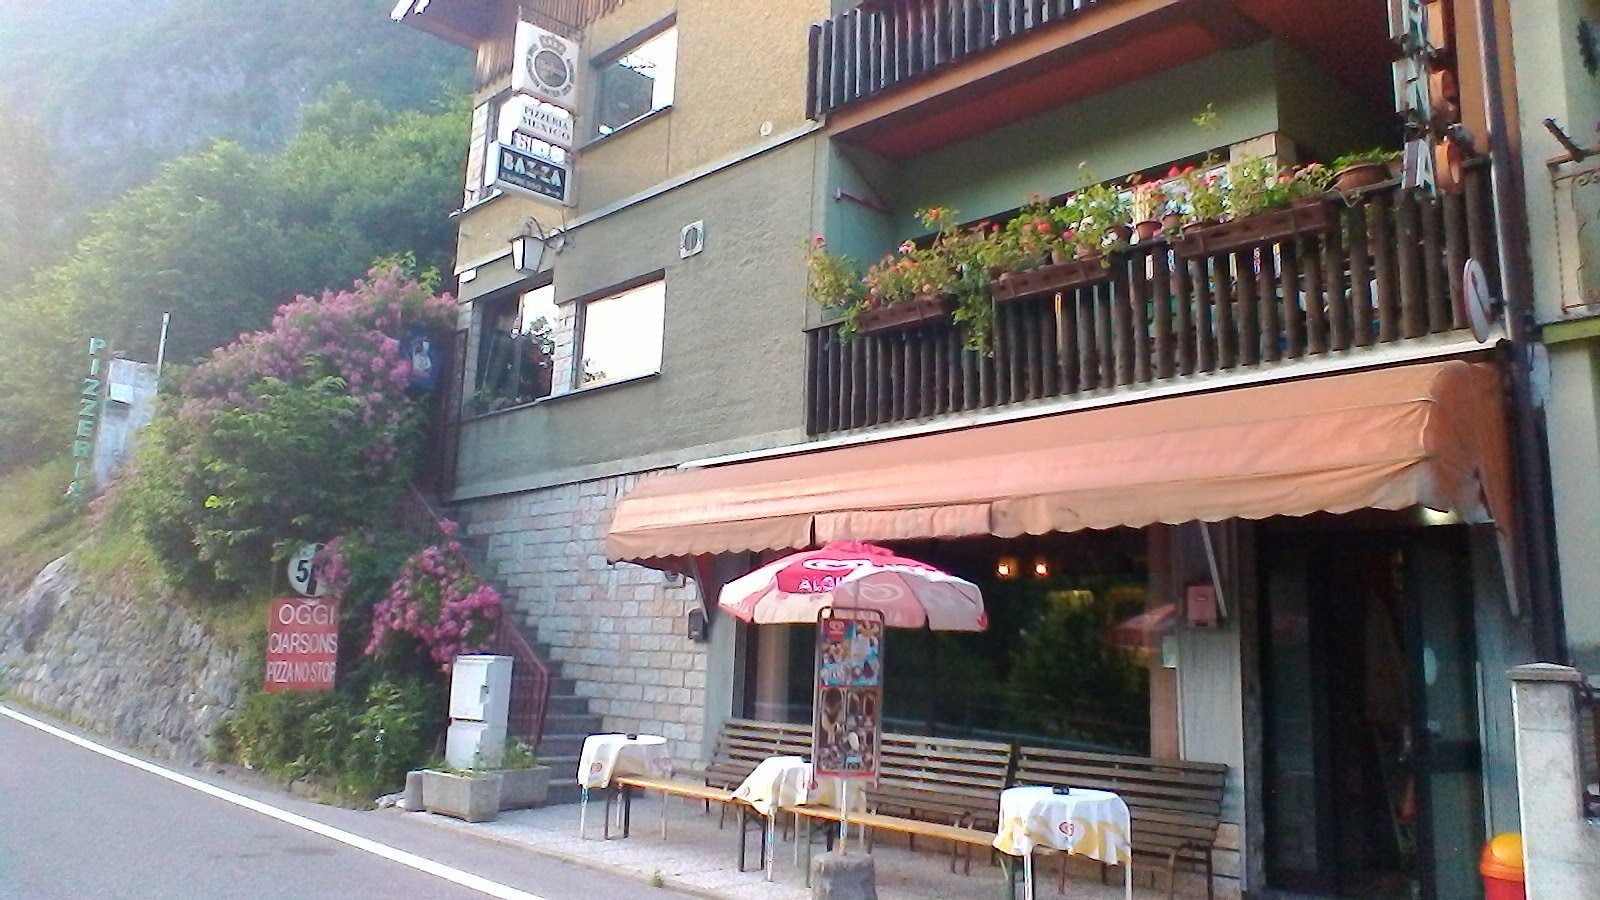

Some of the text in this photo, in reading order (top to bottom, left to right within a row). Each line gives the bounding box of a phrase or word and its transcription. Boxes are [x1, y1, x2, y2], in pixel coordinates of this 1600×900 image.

[524, 106, 569, 130] PIZZERIA
[503, 151, 562, 187] BAZZA
[278, 603, 335, 625] OGGI
[269, 632, 338, 654] CIARSONS
[266, 660, 337, 683] PIZZA NO STOP
